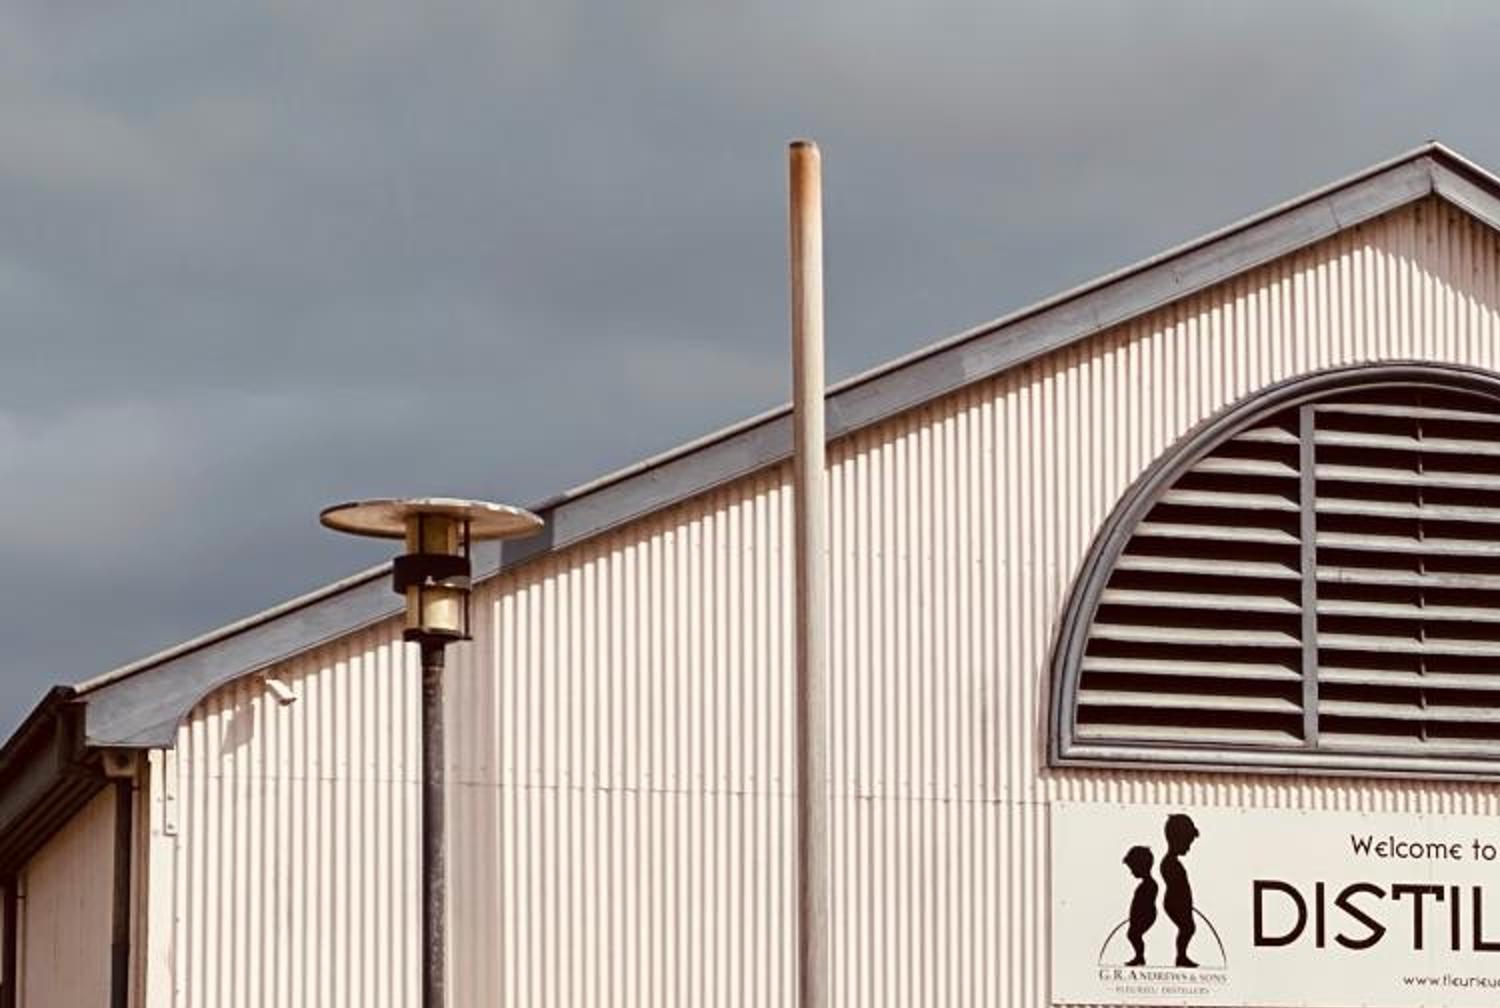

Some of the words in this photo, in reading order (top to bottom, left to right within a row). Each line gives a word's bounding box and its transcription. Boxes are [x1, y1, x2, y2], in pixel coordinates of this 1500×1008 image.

[1350, 833, 1463, 861] Welcome
[1471, 838, 1498, 862] to
[1129, 969, 1188, 983] ANDREWS
[1199, 973, 1228, 984] SONS
